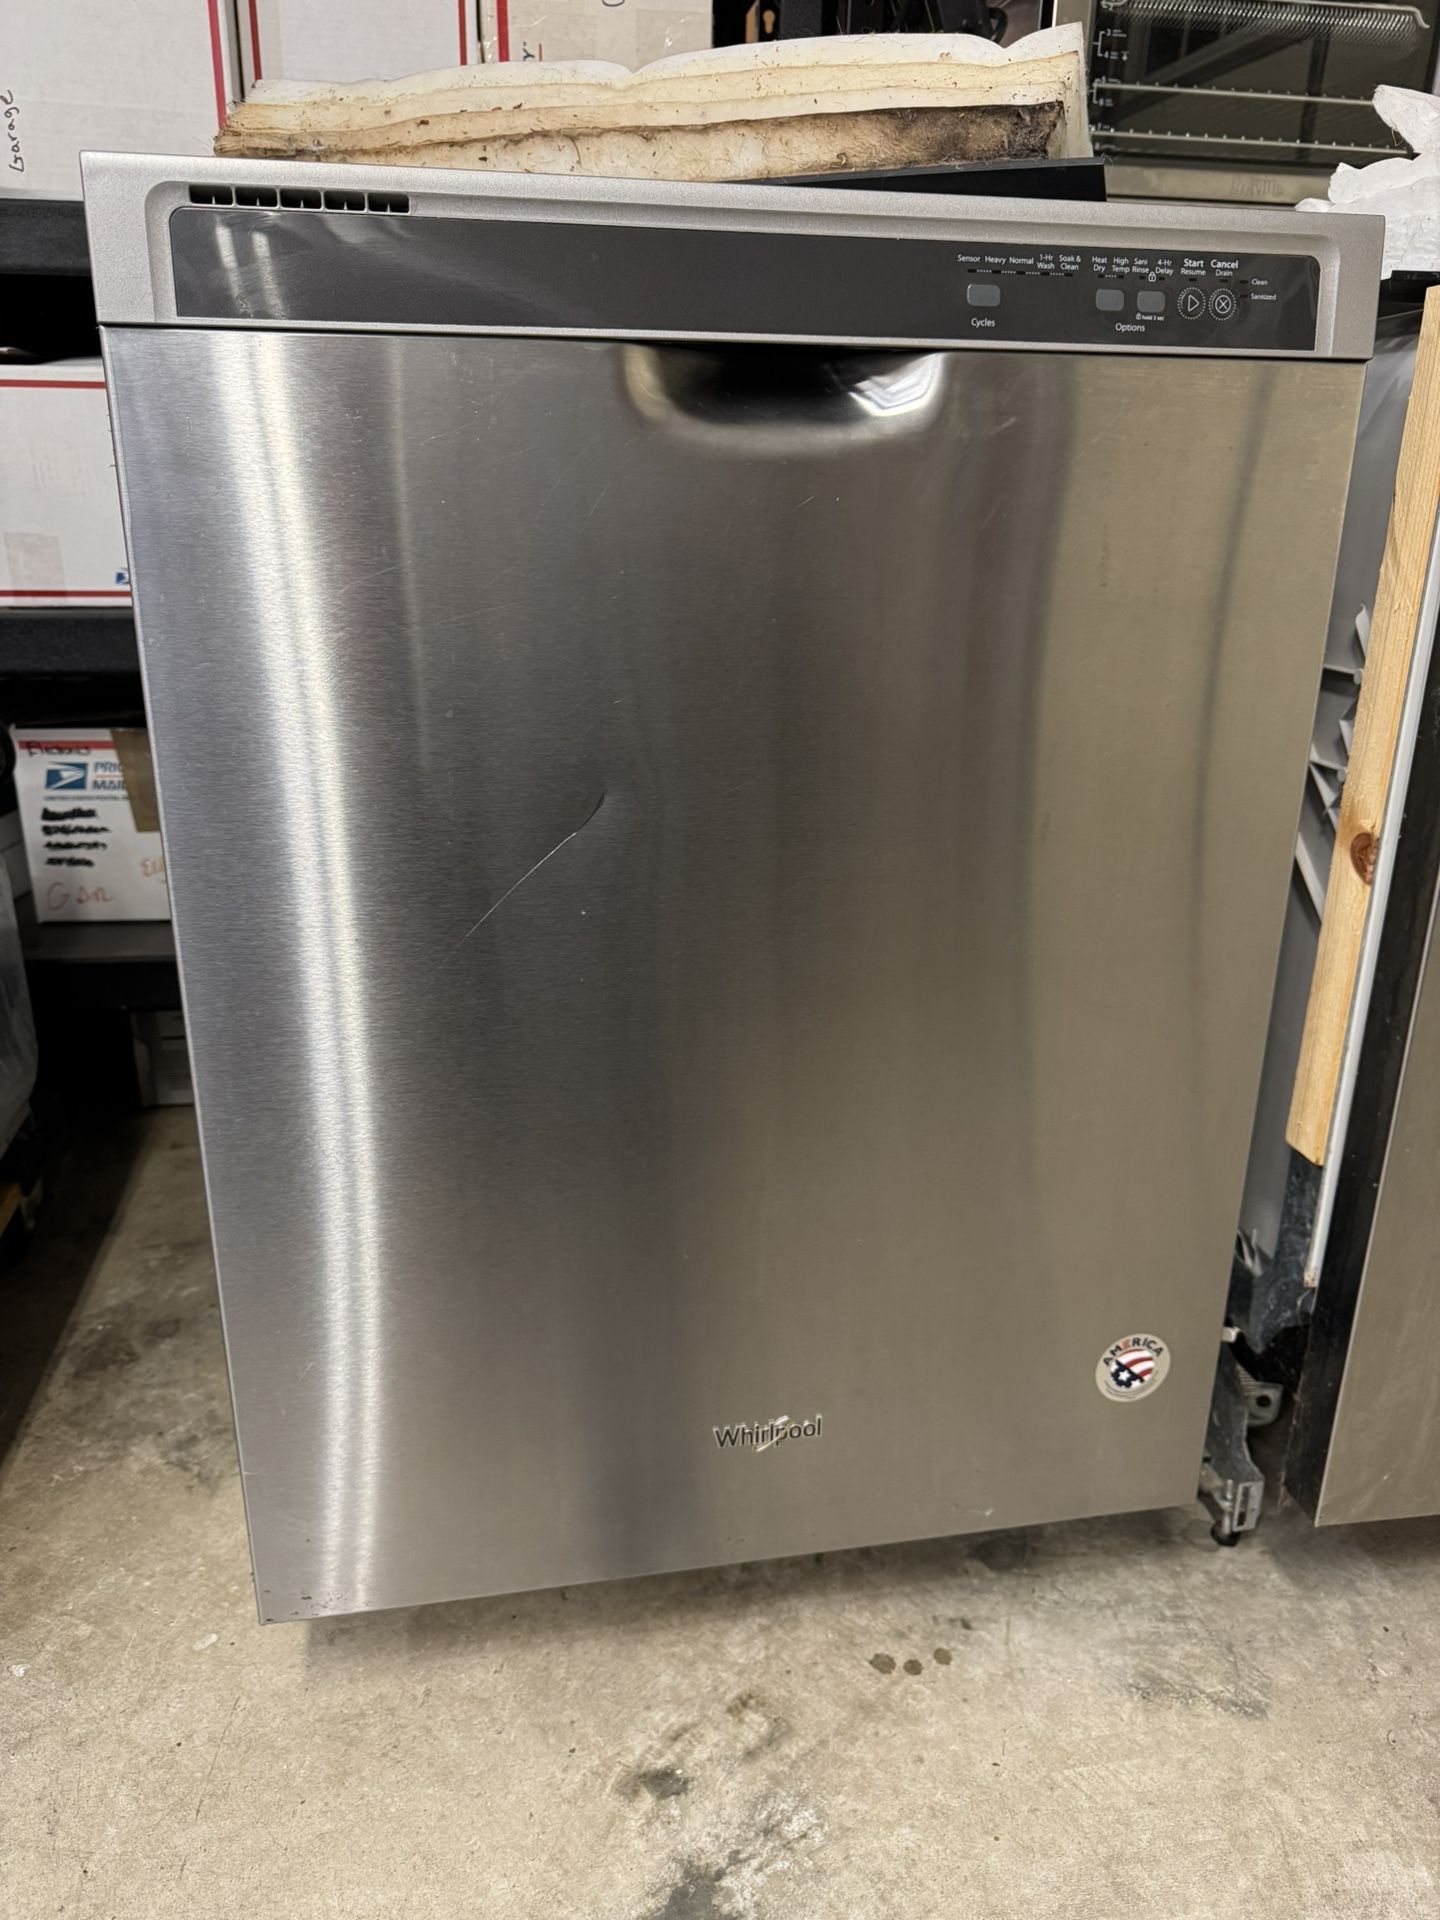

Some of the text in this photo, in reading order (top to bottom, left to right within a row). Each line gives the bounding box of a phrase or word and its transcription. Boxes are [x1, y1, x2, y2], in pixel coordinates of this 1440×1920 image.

[0, 89, 24, 172] Garage
[957, 254, 981, 263] Sensor
[984, 255, 1007, 266] Heavy
[1008, 256, 1035, 265] Normal
[1059, 254, 1081, 263] Soak &
[1091, 256, 1108, 264] Heat
[1113, 256, 1129, 266] High
[1134, 257, 1149, 265] Sani
[1157, 259, 1172, 267] 4-Hr
[1183, 258, 1204, 268] Start
[1036, 262, 1055, 270] Wash
[1060, 263, 1079, 271] Clean
[1093, 264, 1106, 273] Dry
[1210, 259, 1239, 269] Cancel
[1111, 264, 1130, 274] Temp
[1131, 266, 1150, 274] Rinse
[1155, 266, 1174, 276] Delay
[1180, 267, 1206, 276] Resume
[1215, 268, 1233, 277] Drain
[1251, 278, 1268, 286] Clean
[1250, 293, 1277, 301] Sanitized
[970, 317, 996, 328] Cycles
[1115, 322, 1146, 333] Options
[1103, 1337, 1164, 1366] AMERICA
[712, 1413, 823, 1449] Whirlpool
